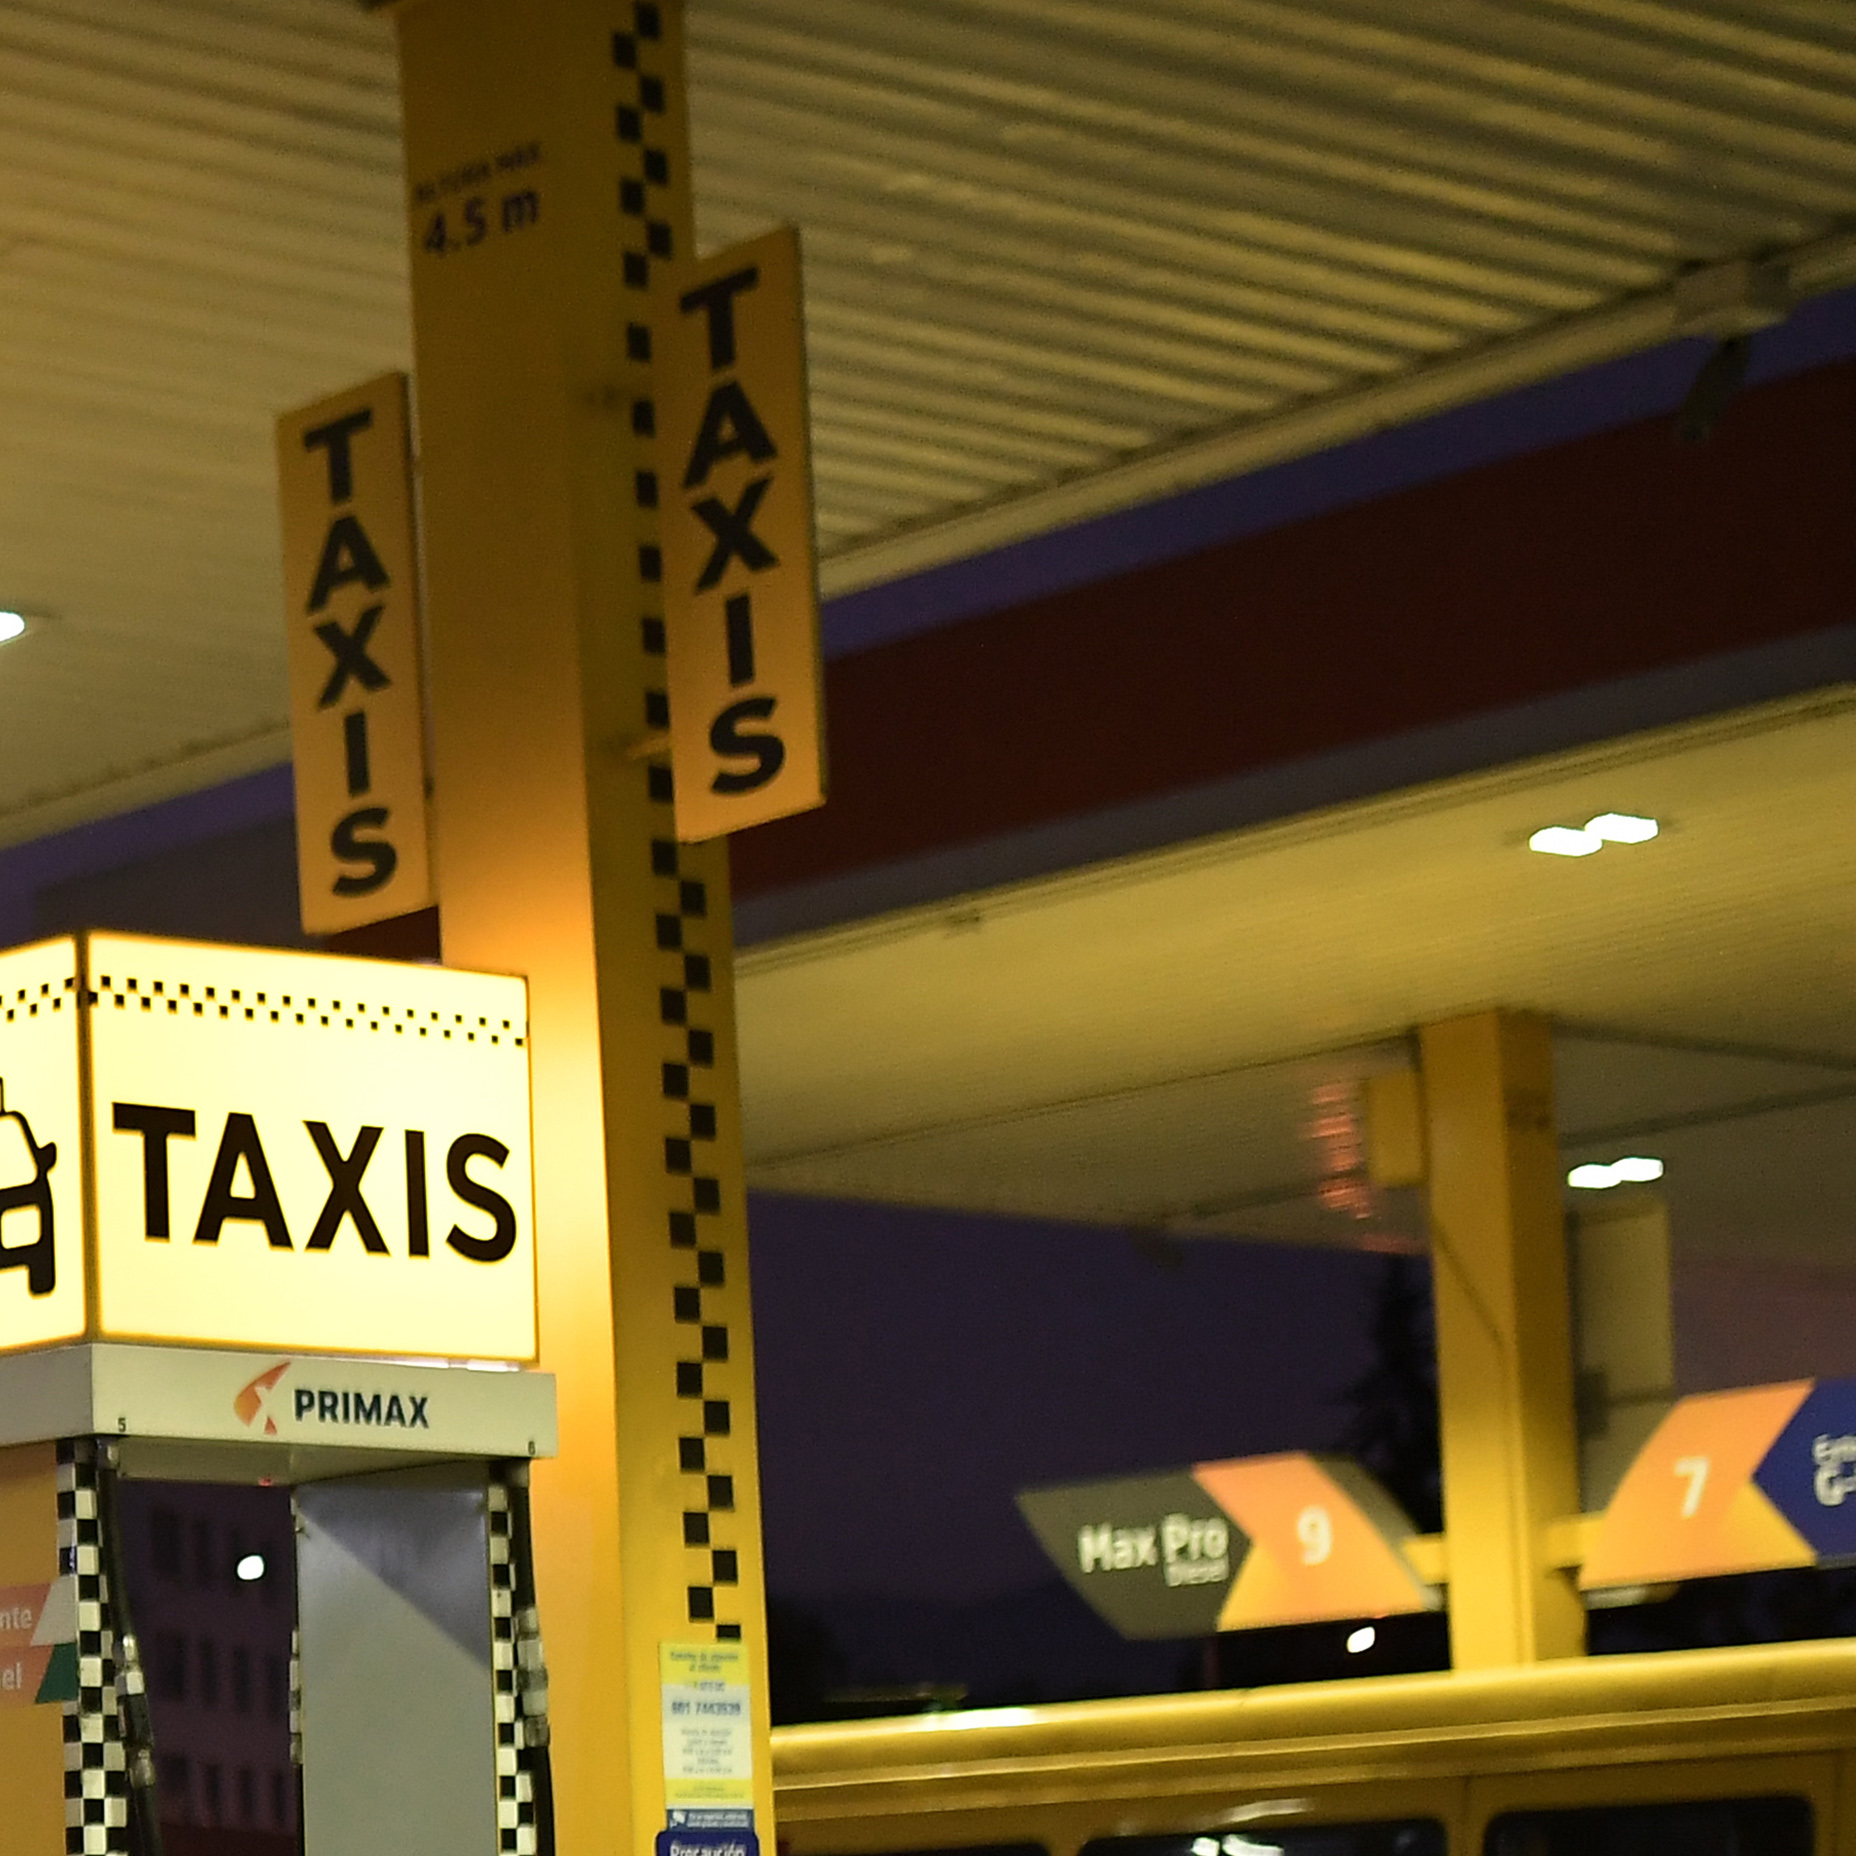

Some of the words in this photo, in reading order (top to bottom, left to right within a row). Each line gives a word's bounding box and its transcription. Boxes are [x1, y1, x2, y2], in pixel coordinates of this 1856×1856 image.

[680, 267, 785, 796] TAXIS
[302, 408, 398, 898] TAXIS
[112, 1101, 518, 1263] TAXIS
[293, 1387, 430, 1430] PRIMAX
[1675, 1456, 1709, 1518] 7
[1078, 1522, 1158, 1574] Max
[1161, 1512, 1229, 1564] Pro
[1296, 1504, 1331, 1566] 9
